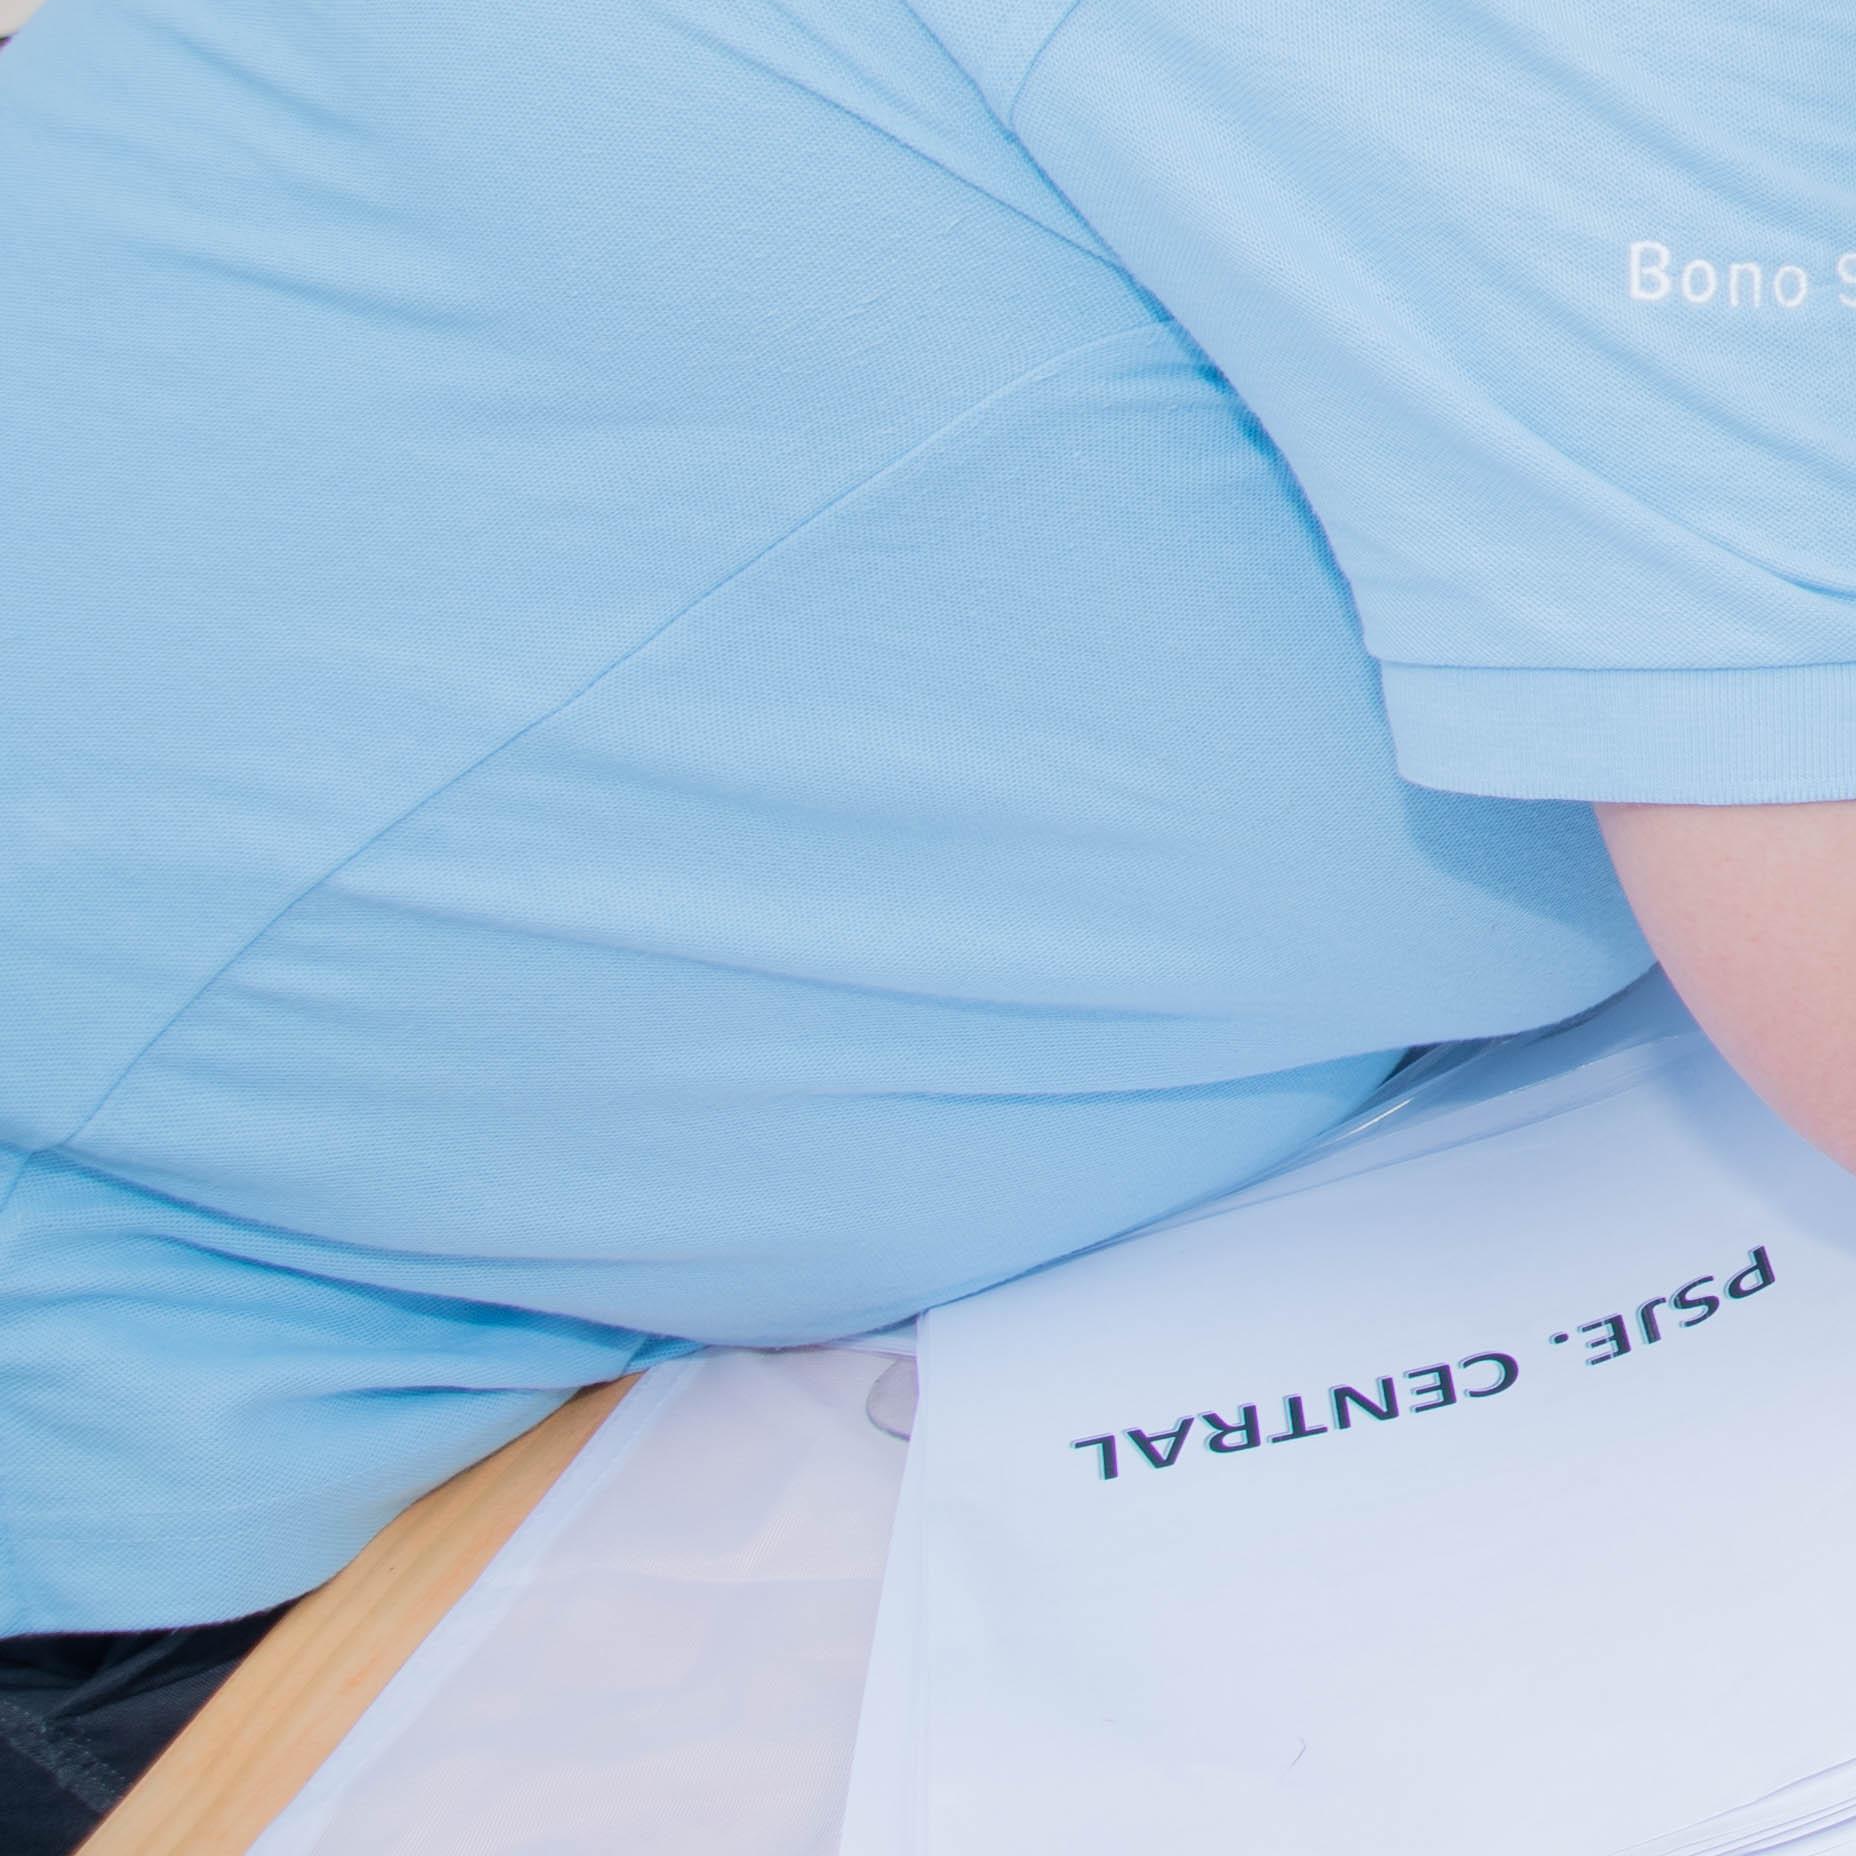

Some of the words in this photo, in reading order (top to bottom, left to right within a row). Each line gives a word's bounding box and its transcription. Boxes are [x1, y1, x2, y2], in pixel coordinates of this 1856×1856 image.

[1628, 240, 1810, 309] Bono
[1547, 1243, 1776, 1367] PSJE.
[1068, 1348, 1521, 1482] CENTRAL
